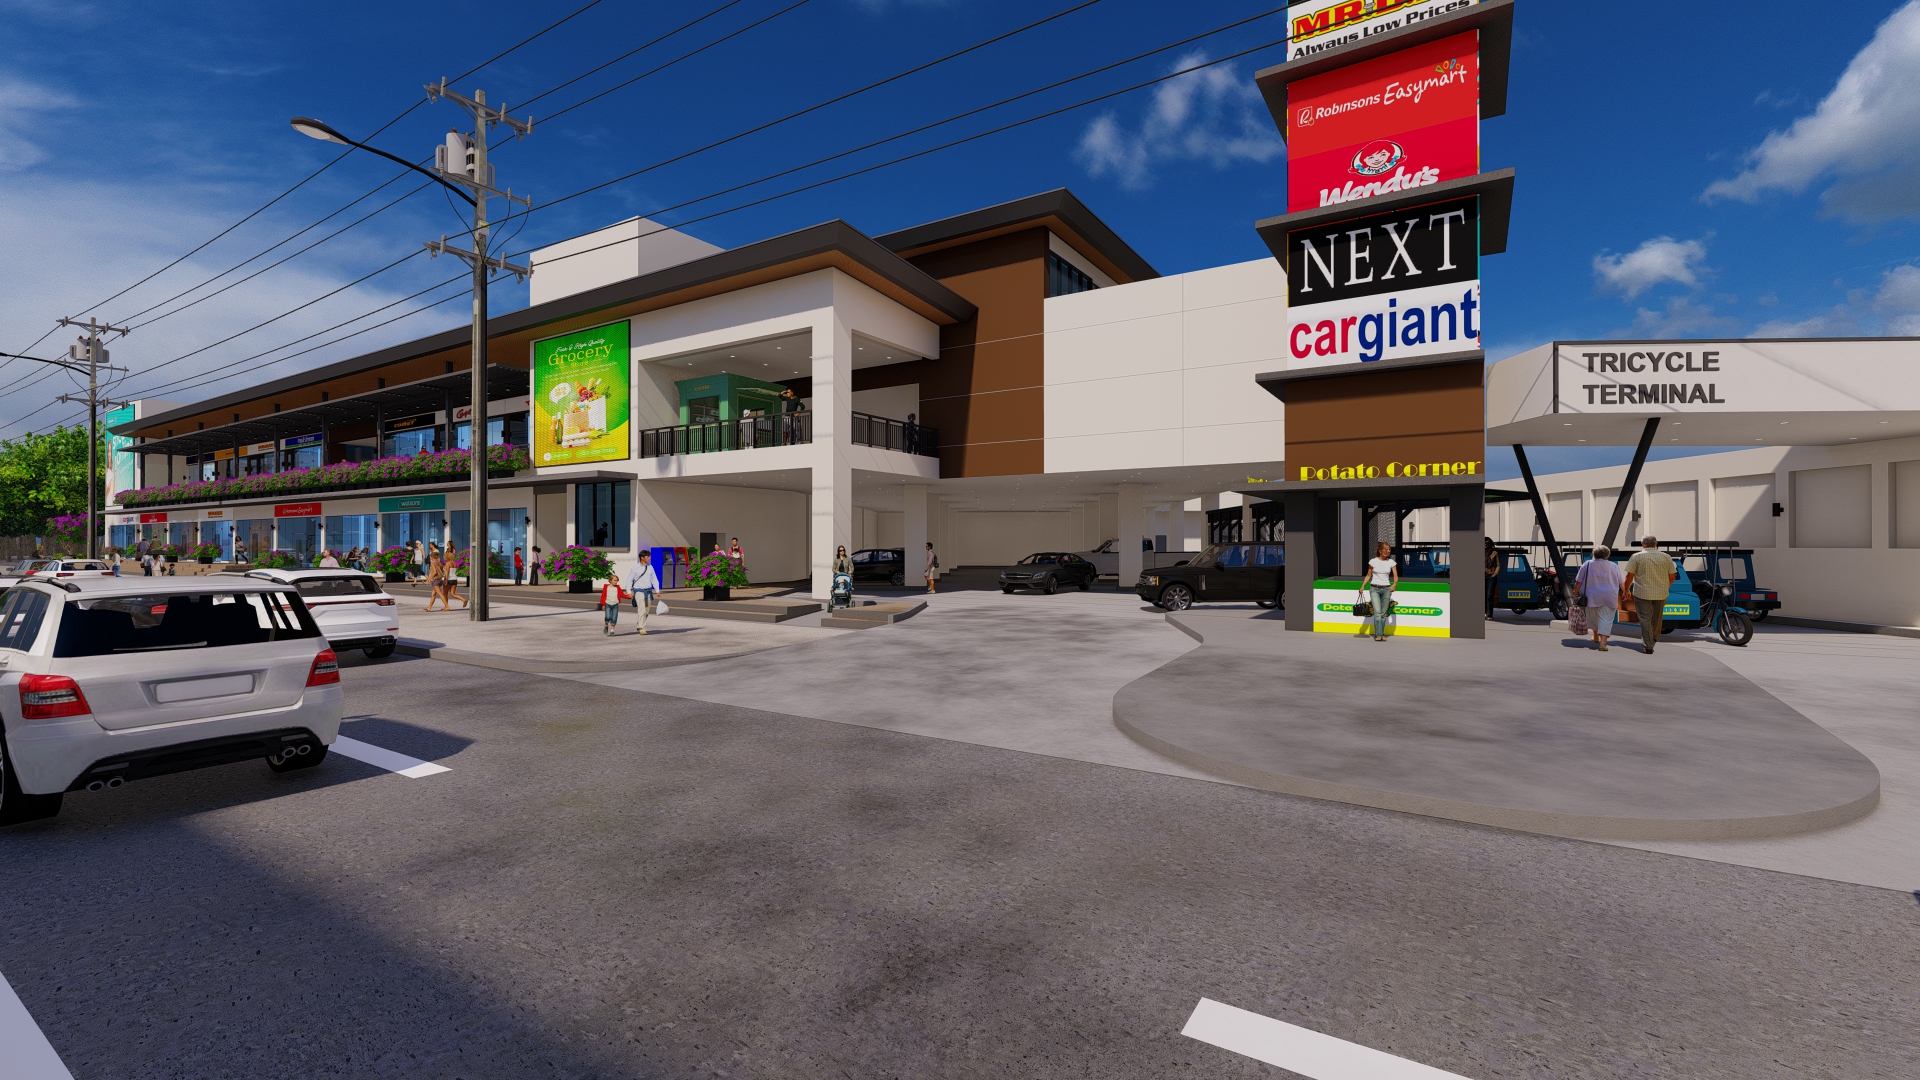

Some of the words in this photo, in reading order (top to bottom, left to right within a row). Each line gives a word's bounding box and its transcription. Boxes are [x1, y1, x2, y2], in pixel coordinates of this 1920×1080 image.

[1293, 31, 1359, 60] Always
[1363, 18, 1402, 38] Low
[1406, 0, 1470, 24] Prices
[1315, 94, 1381, 119] Robinsons
[1383, 64, 1467, 105] Easymart
[1300, 208, 1465, 293] NEXT
[1290, 288, 1478, 362] cargiant
[548, 343, 614, 366] Grocery
[1582, 351, 1720, 372] TRICYCLE
[1582, 383, 1725, 404] TERMINAL
[1300, 463, 1381, 482] Potato
[1386, 461, 1482, 478] Corner
[1322, 603, 1354, 612] Pota
